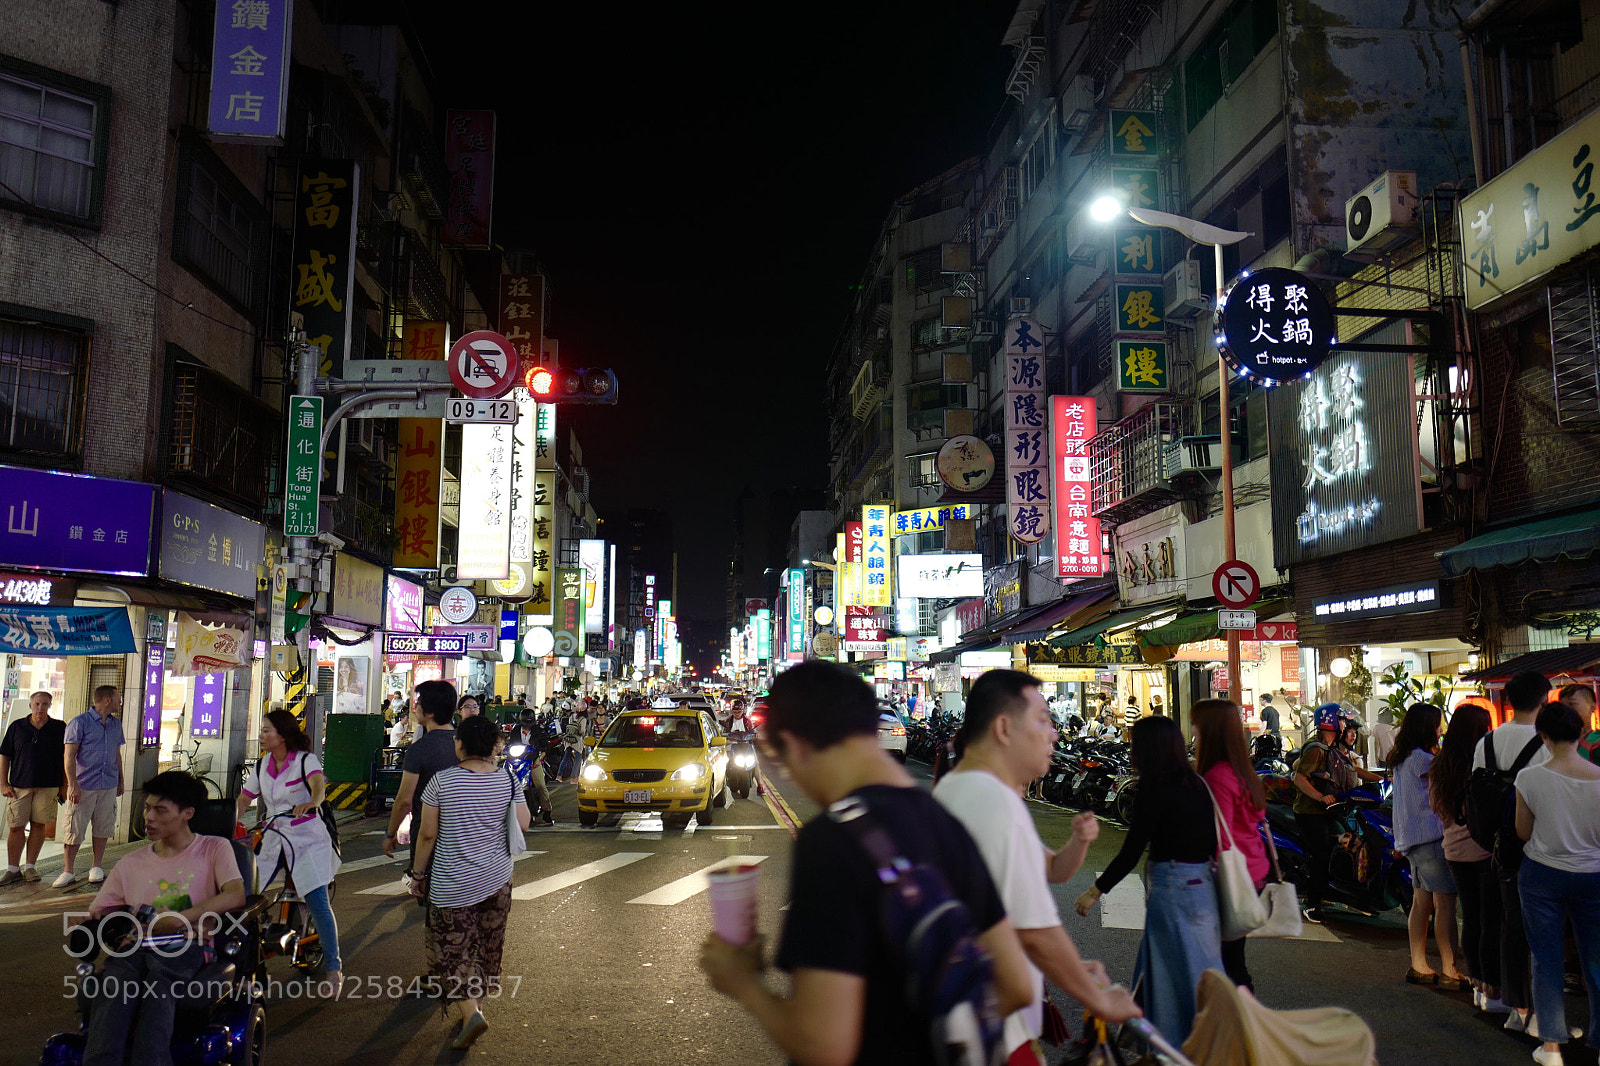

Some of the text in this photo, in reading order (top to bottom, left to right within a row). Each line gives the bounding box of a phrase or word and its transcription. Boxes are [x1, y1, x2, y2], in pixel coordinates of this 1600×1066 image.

[1115, 114, 1164, 386] 金永利銀樓
[452, 401, 510, 421] 09-12
[1011, 320, 1048, 538] 本源隱形眼鏡
[1064, 402, 1086, 456] 老店頭
[295, 411, 315, 482] 通化街
[395, 327, 441, 558] 楊山銀樓
[288, 483, 312, 493] Tong
[288, 493, 307, 501] Hua
[288, 502, 300, 511] St.
[7, 500, 40, 538] 山
[867, 508, 886, 586] 年青人眼鏡
